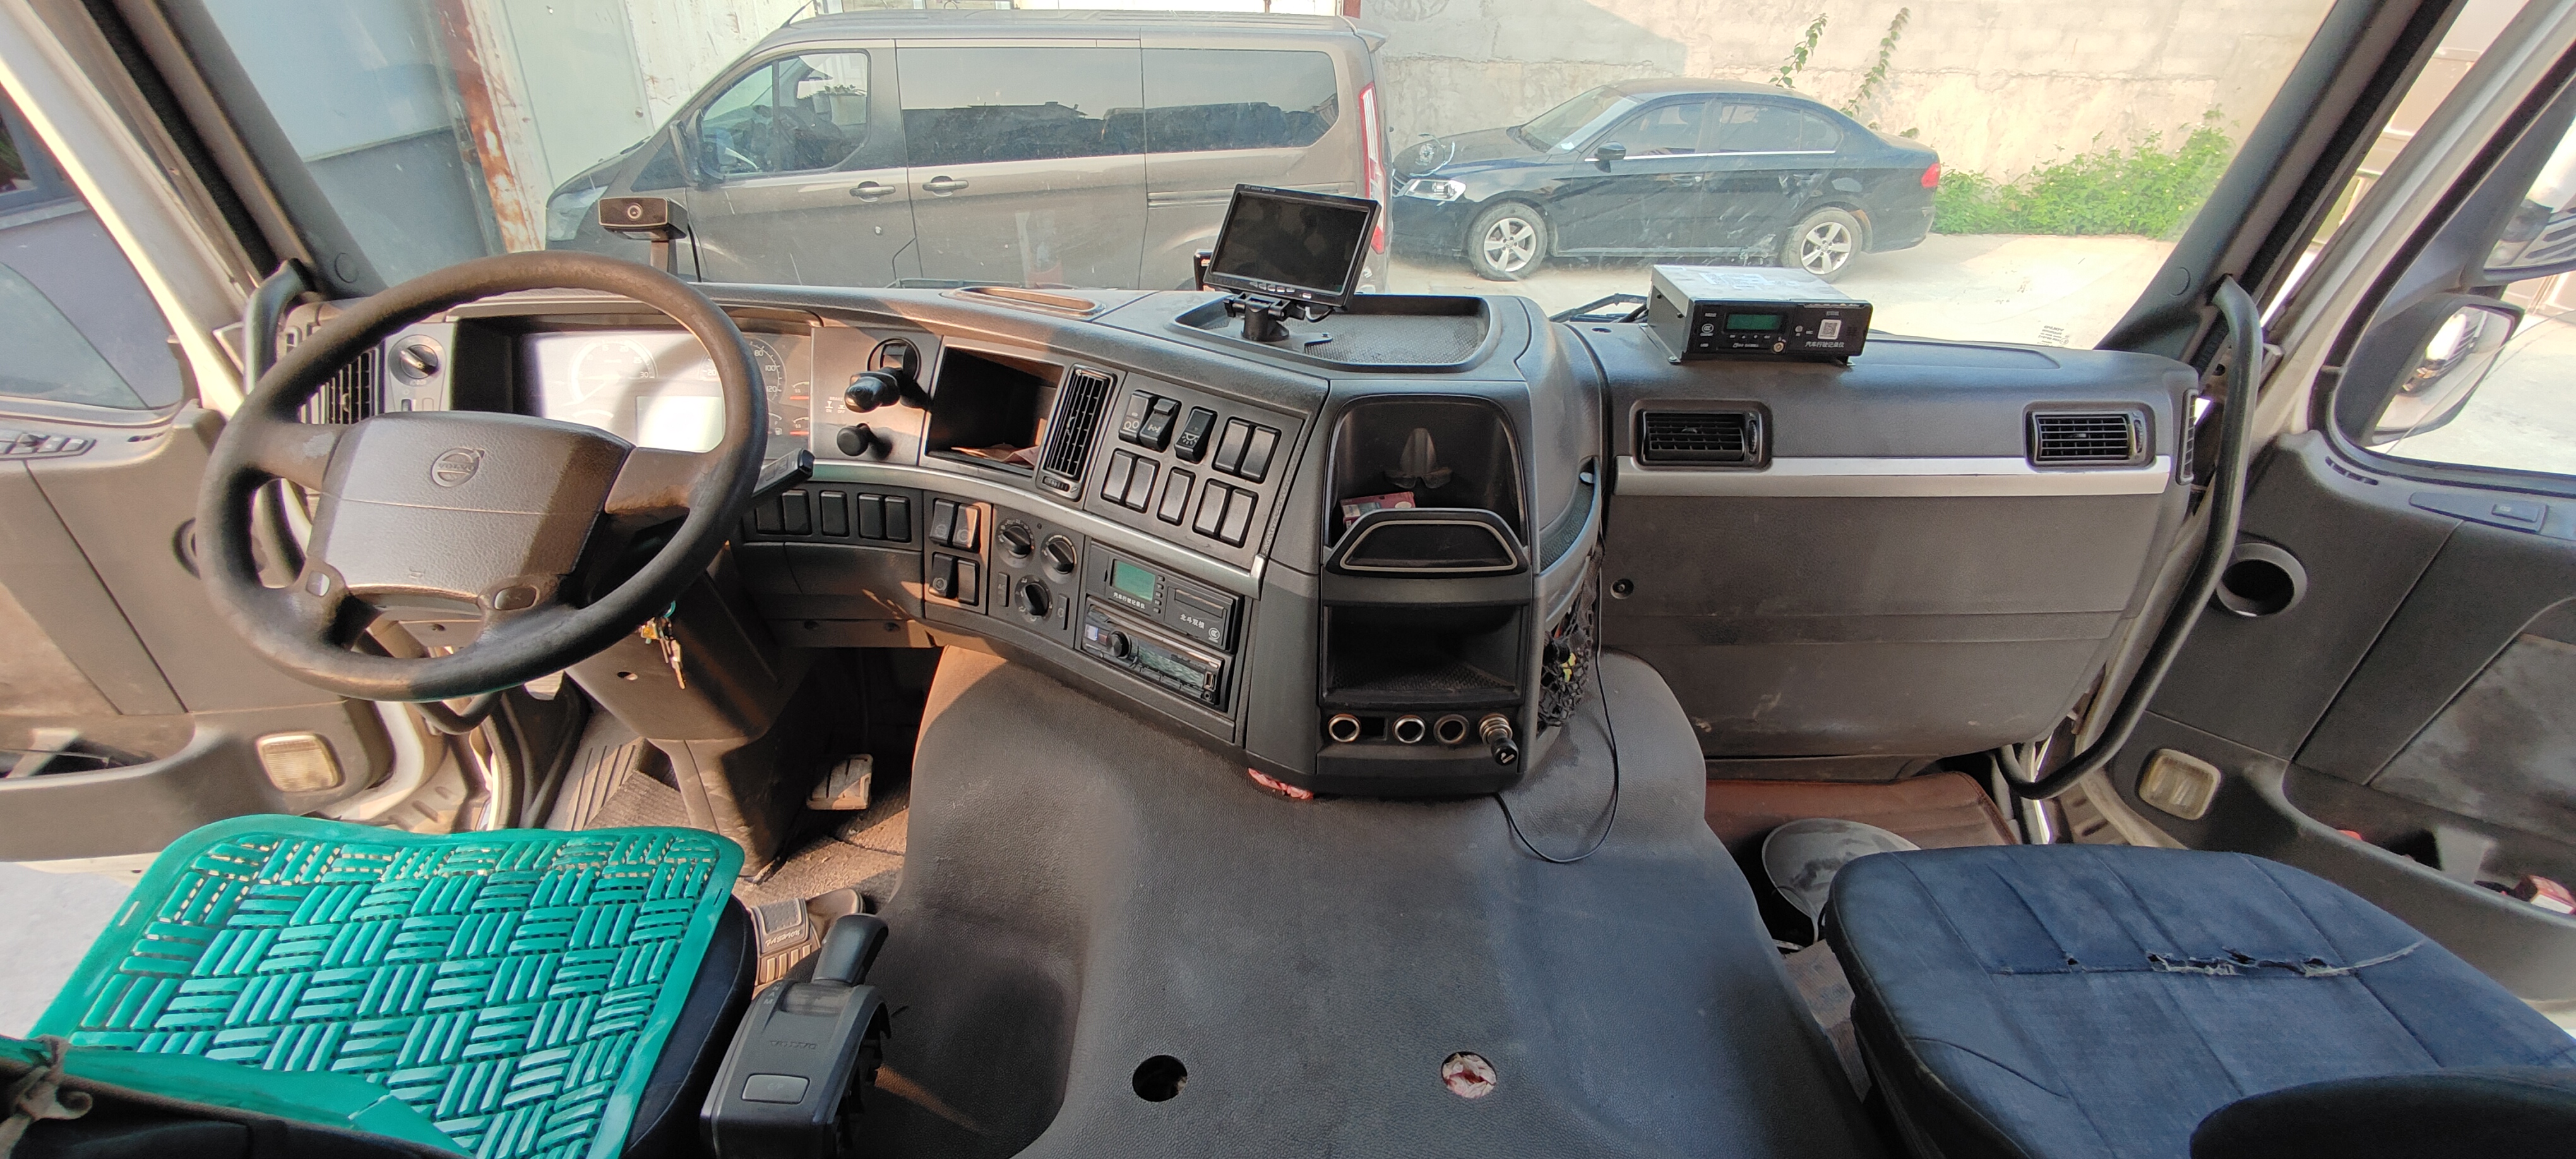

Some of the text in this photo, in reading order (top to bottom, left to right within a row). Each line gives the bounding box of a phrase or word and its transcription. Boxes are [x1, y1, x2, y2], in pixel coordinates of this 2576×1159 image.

[1112, 591, 1146, 610] 汽车行驶记录仪
[1180, 613, 1205, 629] 北斗双模
